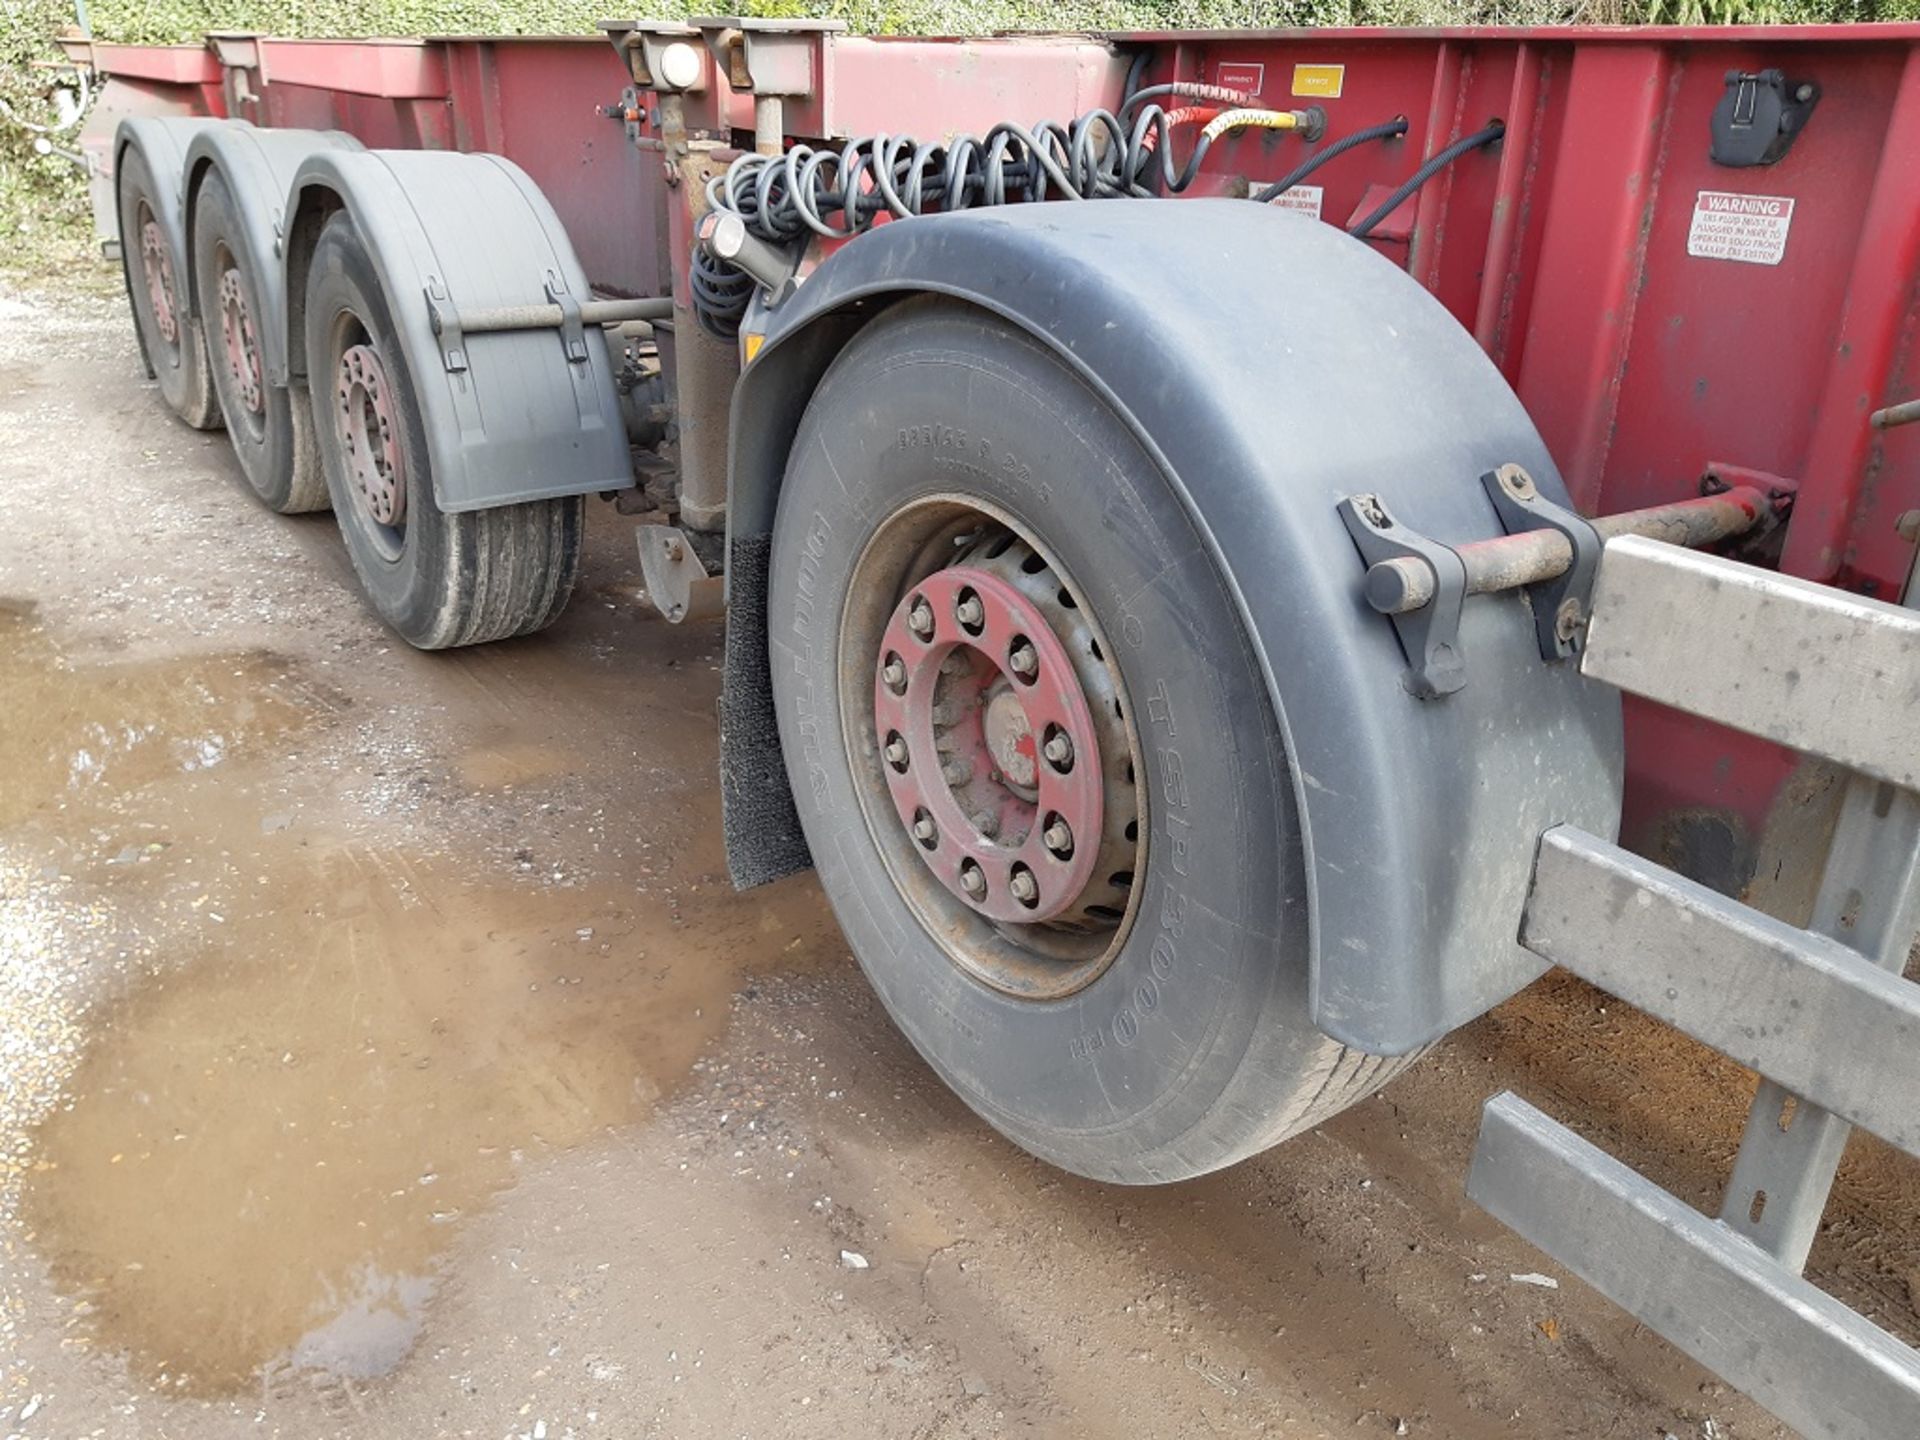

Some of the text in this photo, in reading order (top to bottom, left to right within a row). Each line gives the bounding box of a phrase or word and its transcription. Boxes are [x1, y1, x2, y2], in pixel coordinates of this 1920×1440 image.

[1708, 196, 1780, 215] WARNING
[1742, 217, 1766, 227] MUST
[1691, 233, 1727, 244] OPERATE
[1695, 223, 1781, 239] PLUGGED IN HERE TO
[1694, 244, 1726, 254] TRAILER
[1744, 249, 1776, 260] SYSTEM
